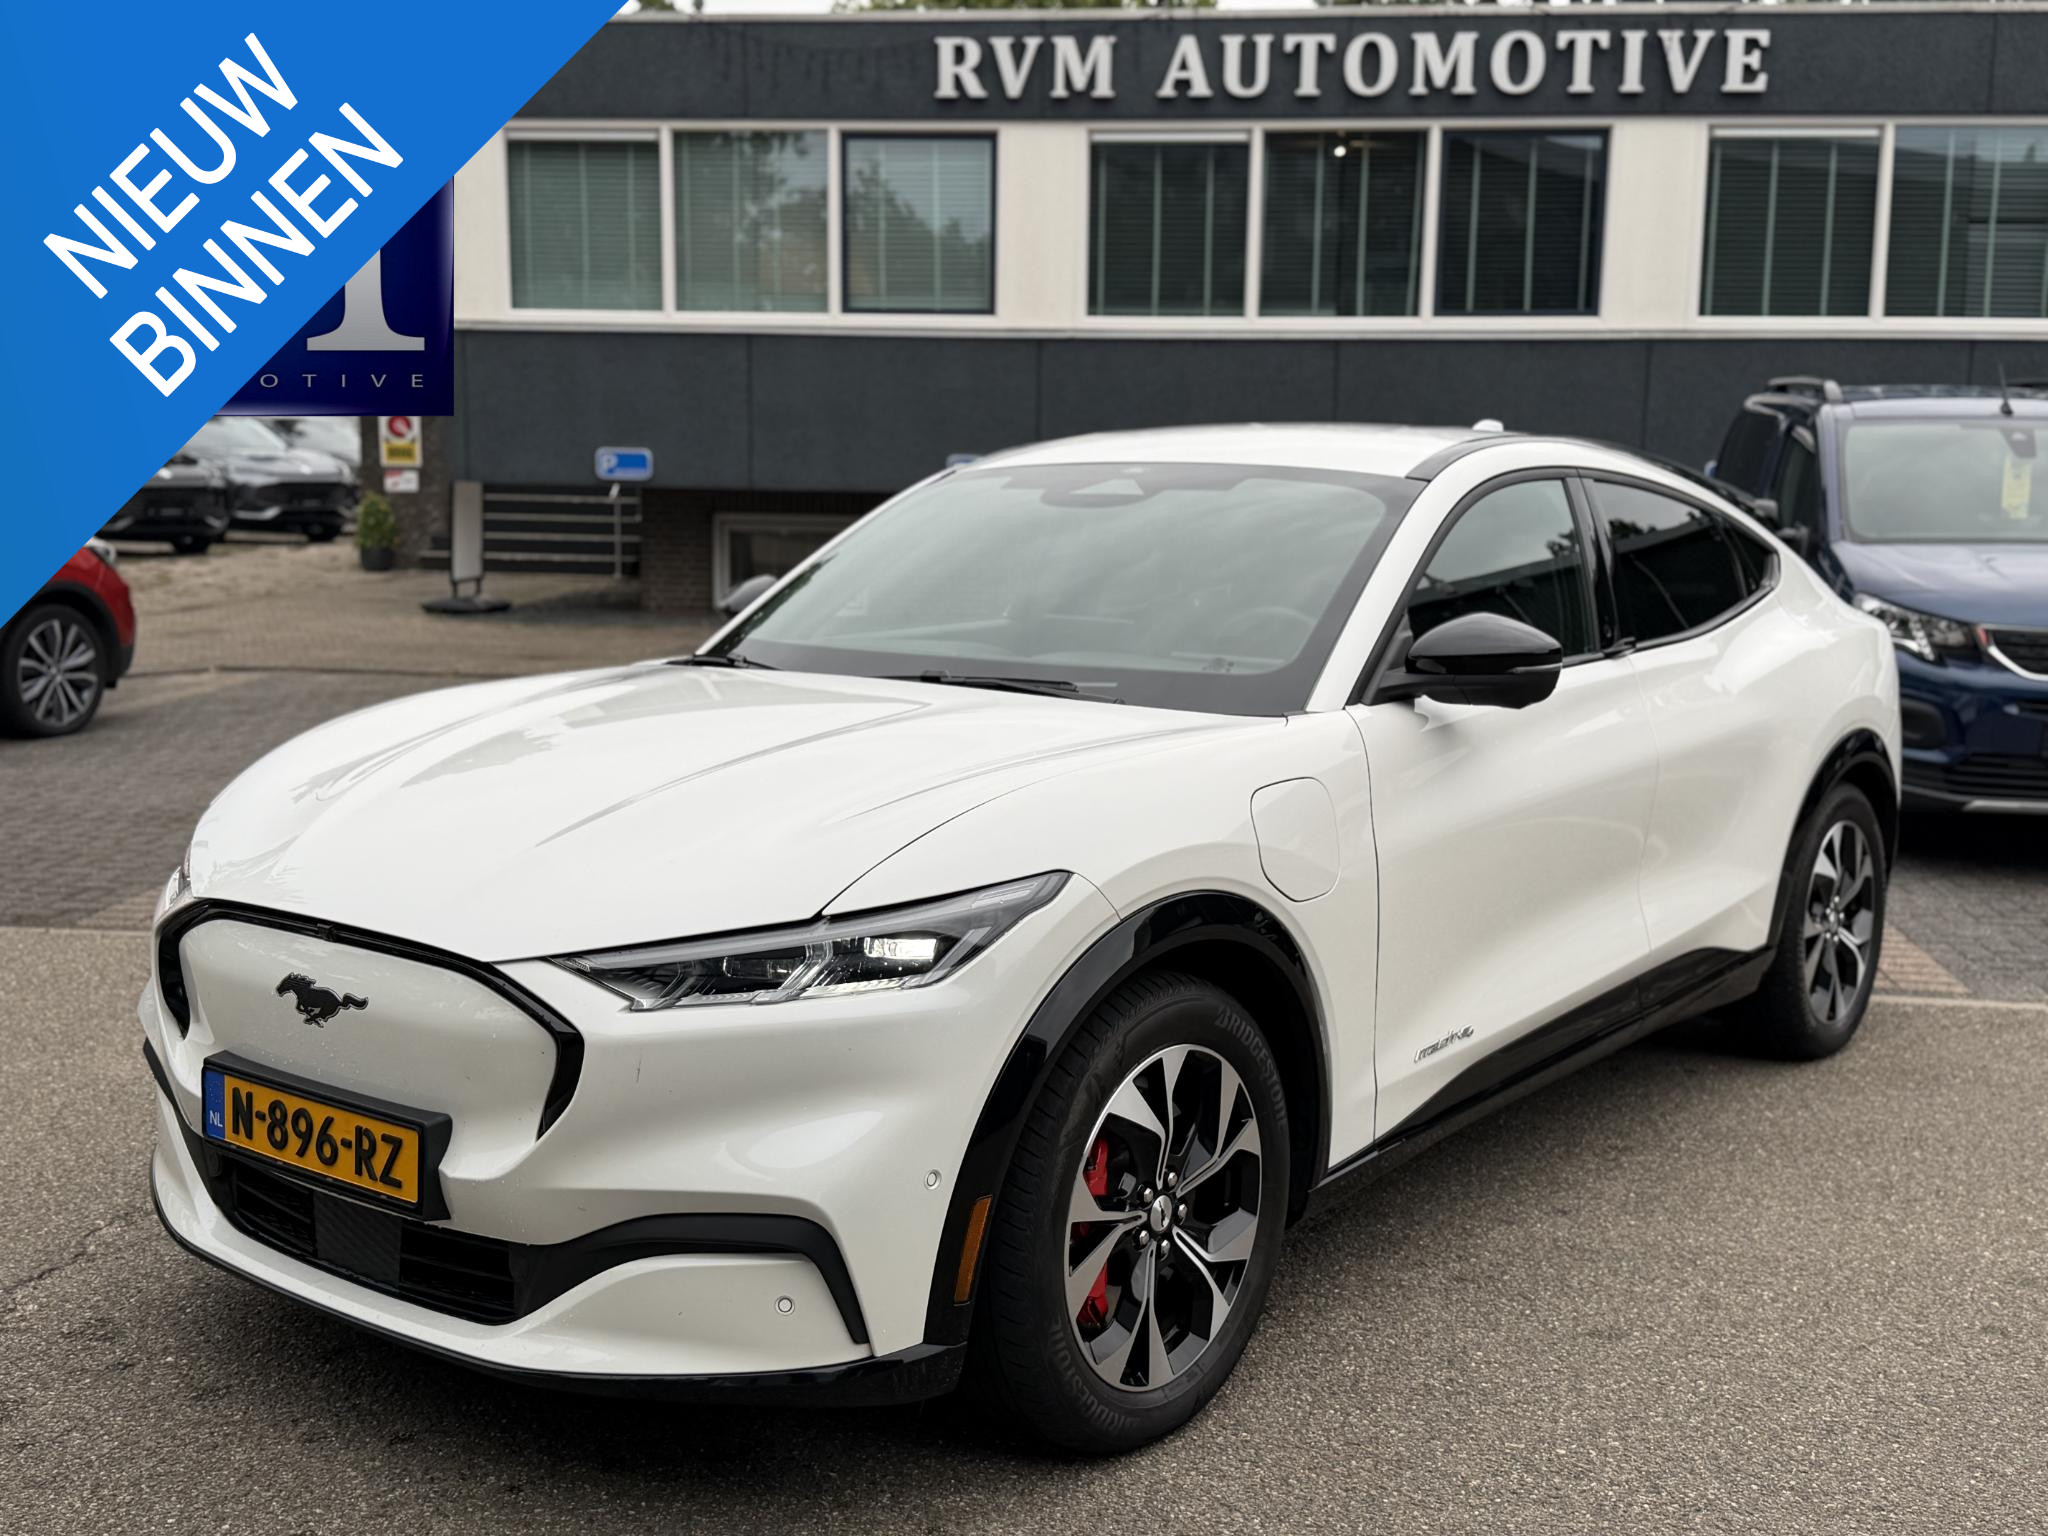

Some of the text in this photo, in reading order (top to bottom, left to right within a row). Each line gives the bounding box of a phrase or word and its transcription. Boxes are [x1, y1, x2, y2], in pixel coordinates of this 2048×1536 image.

[934, 29, 1772, 100] RVM AUTOMOTIVE
[209, 1086, 403, 1189] NL N-896-RZ
